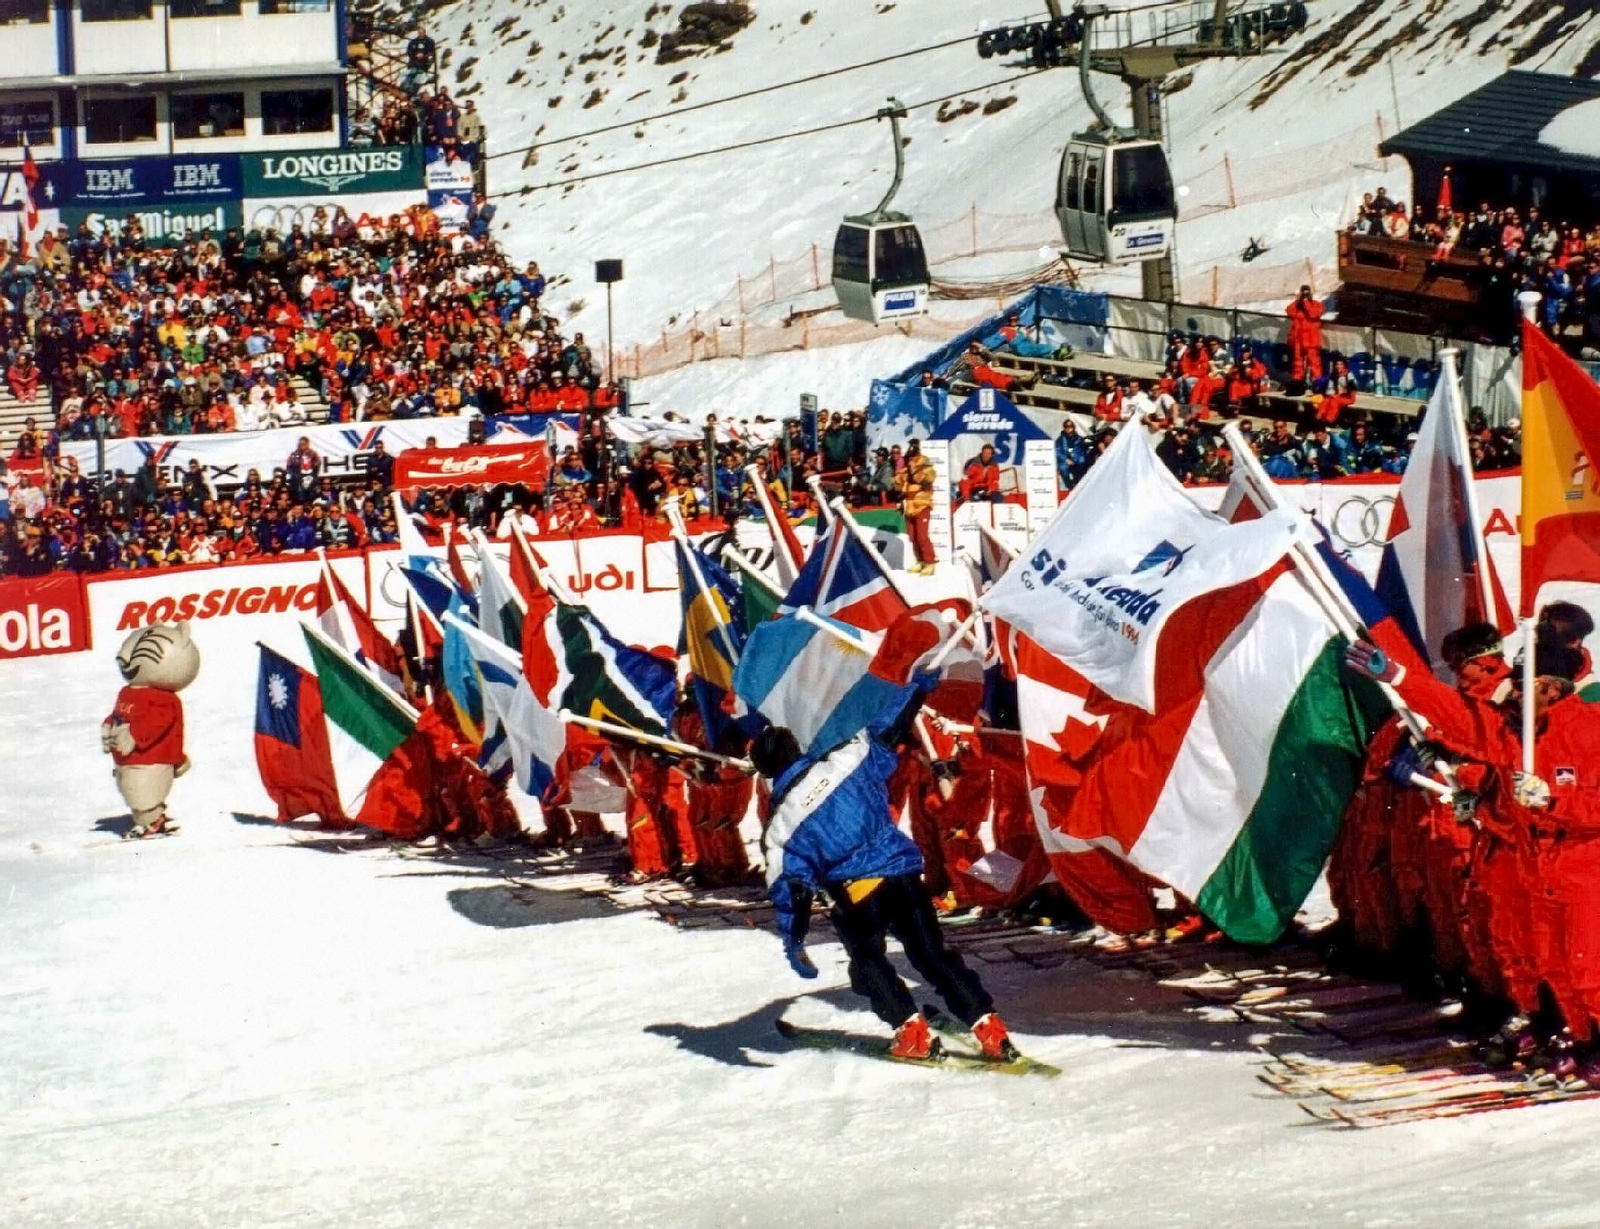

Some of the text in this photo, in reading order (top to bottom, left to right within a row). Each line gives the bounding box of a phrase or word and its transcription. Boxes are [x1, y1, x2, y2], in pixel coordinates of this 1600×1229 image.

[173, 164, 220, 187] IBM
[263, 151, 402, 178] LONGINES
[86, 168, 134, 191] IBM
[134, 206, 224, 240] Miguel
[962, 411, 1000, 422] sierra
[967, 418, 1014, 430] nevada
[568, 563, 634, 593] udi
[116, 582, 320, 631] ROSSIGNO
[0, 603, 72, 651] ola
